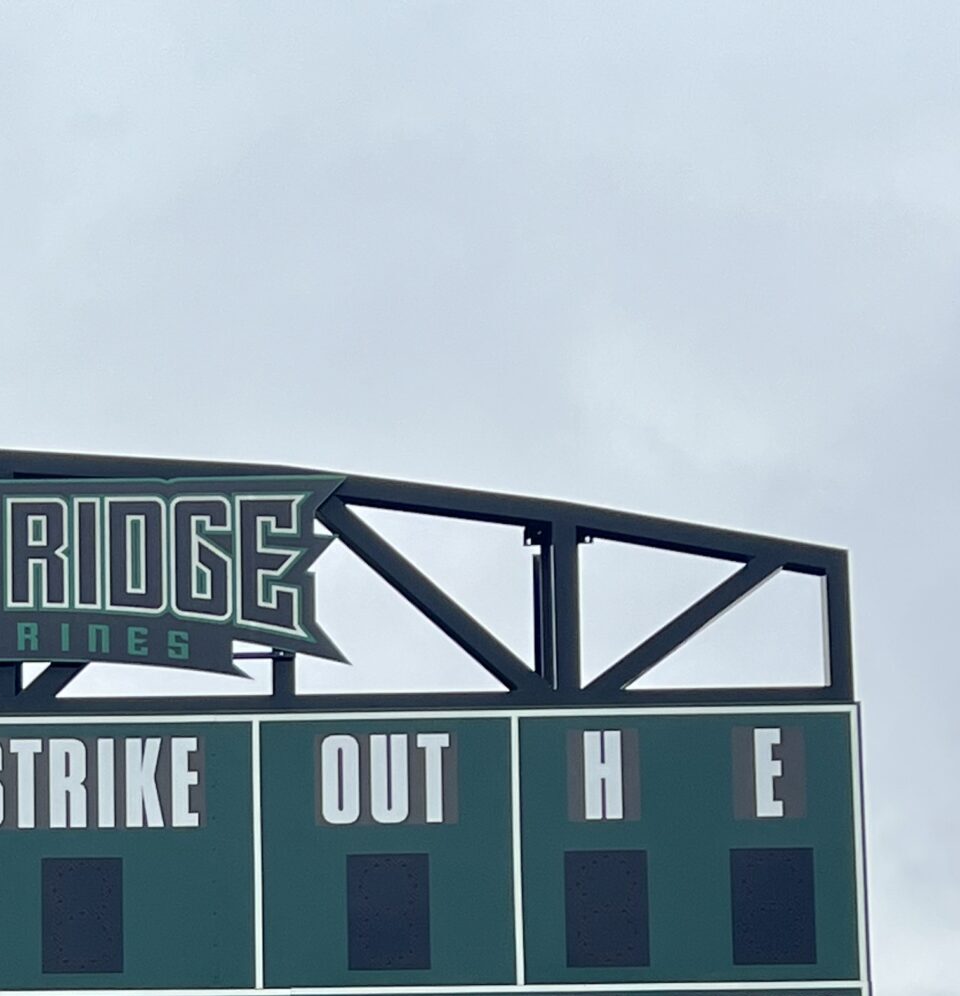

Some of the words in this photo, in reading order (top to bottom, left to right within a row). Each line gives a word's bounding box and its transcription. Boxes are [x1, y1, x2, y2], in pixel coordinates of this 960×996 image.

[3, 492, 314, 642] RIDGE
[321, 733, 450, 825] OUT
[583, 730, 623, 820] H
[754, 728, 784, 818] E
